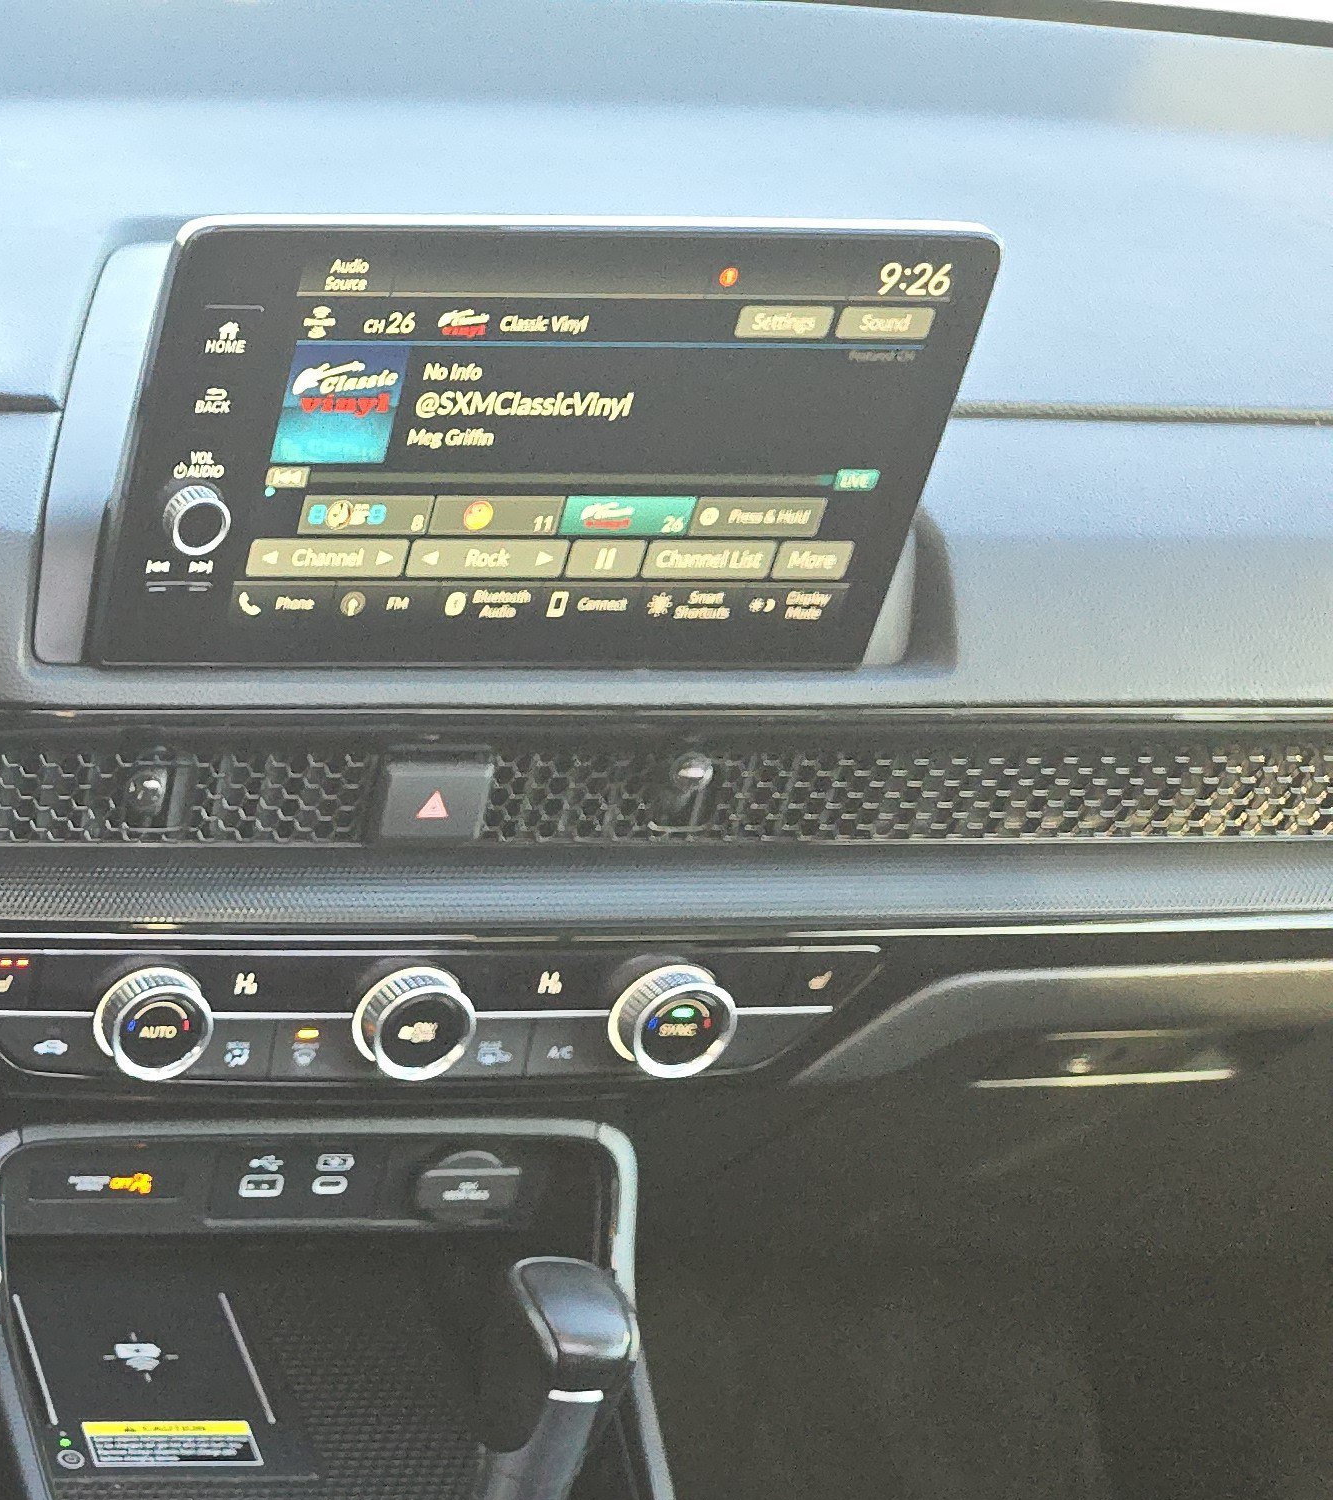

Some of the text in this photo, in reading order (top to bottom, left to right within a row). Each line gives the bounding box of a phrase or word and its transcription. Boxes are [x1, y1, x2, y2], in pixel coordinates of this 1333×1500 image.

[330, 258, 369, 274] Audio
[324, 276, 368, 292] Source
[877, 262, 952, 296] 9:26
[363, 317, 386, 334] CH
[386, 311, 416, 335] 26
[499, 314, 550, 333] Classic
[551, 314, 590, 335] Vinyl
[751, 311, 816, 333] Settings
[858, 313, 912, 333] Sound
[204, 340, 247, 354] HOME
[423, 363, 483, 381] No Info
[320, 370, 399, 395] Classic
[194, 400, 231, 414] BACK
[300, 393, 391, 417] vinyl
[415, 391, 635, 421] @SXMClassicVinyl
[406, 429, 495, 449] Meg Griffin
[190, 451, 215, 464] VOL
[185, 465, 226, 479] AUDIO
[410, 514, 425, 531] 8
[533, 515, 554, 532] 11
[661, 516, 684, 533] 26
[291, 549, 364, 567] Channel
[464, 549, 511, 567] Rock
[655, 549, 763, 570] Channel List
[786, 550, 838, 569] More
[274, 596, 315, 610] Phone
[386, 596, 410, 610] FM
[139, 1025, 178, 1039] AUTO
